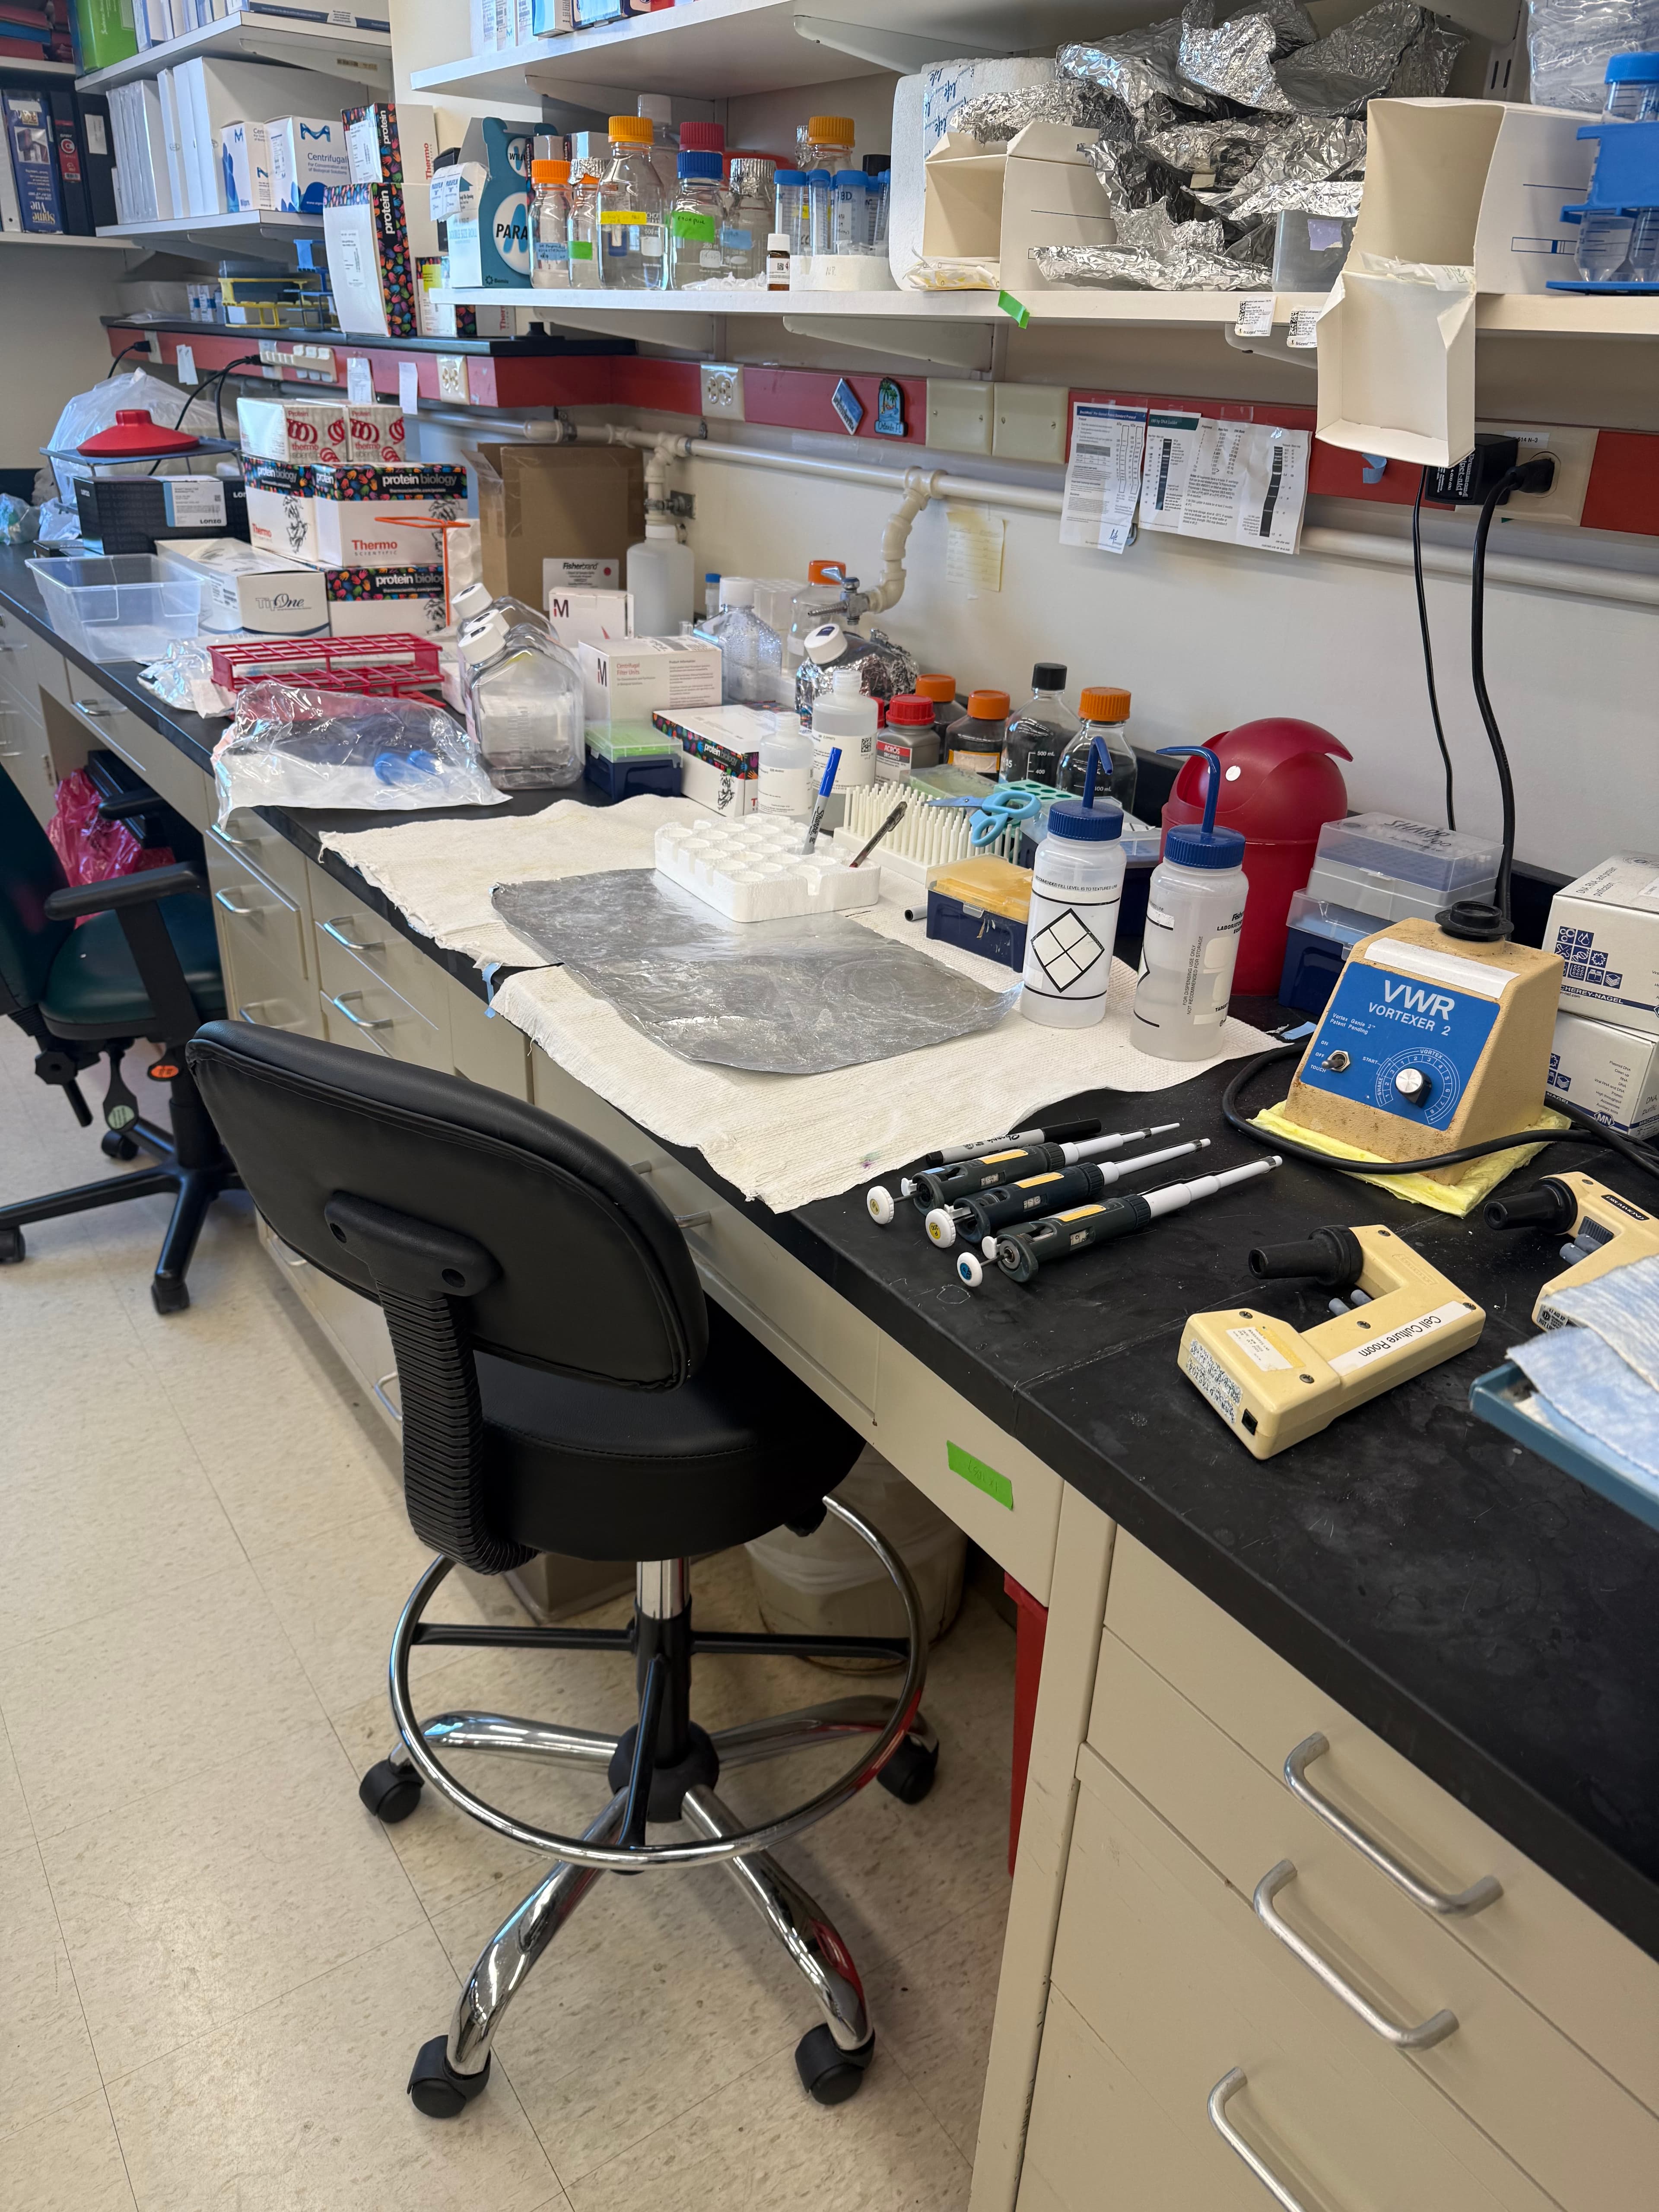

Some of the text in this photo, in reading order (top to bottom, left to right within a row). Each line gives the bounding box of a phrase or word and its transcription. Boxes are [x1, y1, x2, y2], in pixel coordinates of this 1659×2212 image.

[944, 80, 957, 102] life
[380, 110, 391, 144] protein
[934, 115, 947, 137] life
[308, 152, 348, 164] Centrifugal
[424, 143, 433, 180] Thermo
[30, 201, 46, 213] Vue
[381, 190, 395, 235] protein
[257, 467, 297, 483] protein biology
[316, 472, 334, 485] protein
[382, 475, 458, 487] protein biology
[252, 523, 272, 537] Thermo
[351, 540, 398, 550] Thermo
[375, 574, 413, 587] protein
[255, 594, 304, 611] TipOne
[704, 743, 738, 766] protein biology
[884, 745, 900, 754] ACROS
[1384, 820, 1451, 838] SHARP
[1188, 969, 1198, 1004] RECOMMENDED
[1560, 985, 1624, 1004] CHEREY-NAGEL
[1384, 979, 1455, 1021] VWR
[1330, 1019, 1369, 1035] Patent Pending
[1332, 1013, 1348, 1023] Vortex
[1350, 1018, 1366, 1027] Genie
[1368, 1002, 1451, 1036] VORTEXER 2
[1362, 1056, 1379, 1065] START
[1420, 1049, 1443, 1059] VORTEX
[1310, 1064, 1327, 1073] TOUCH
[1601, 1099, 1620, 1109] Accessories
[1598, 1113, 1611, 1125] MN
[1606, 1196, 1644, 1220] DRUMMOND
[1358, 1316, 1441, 1357] Cell Culture Room
